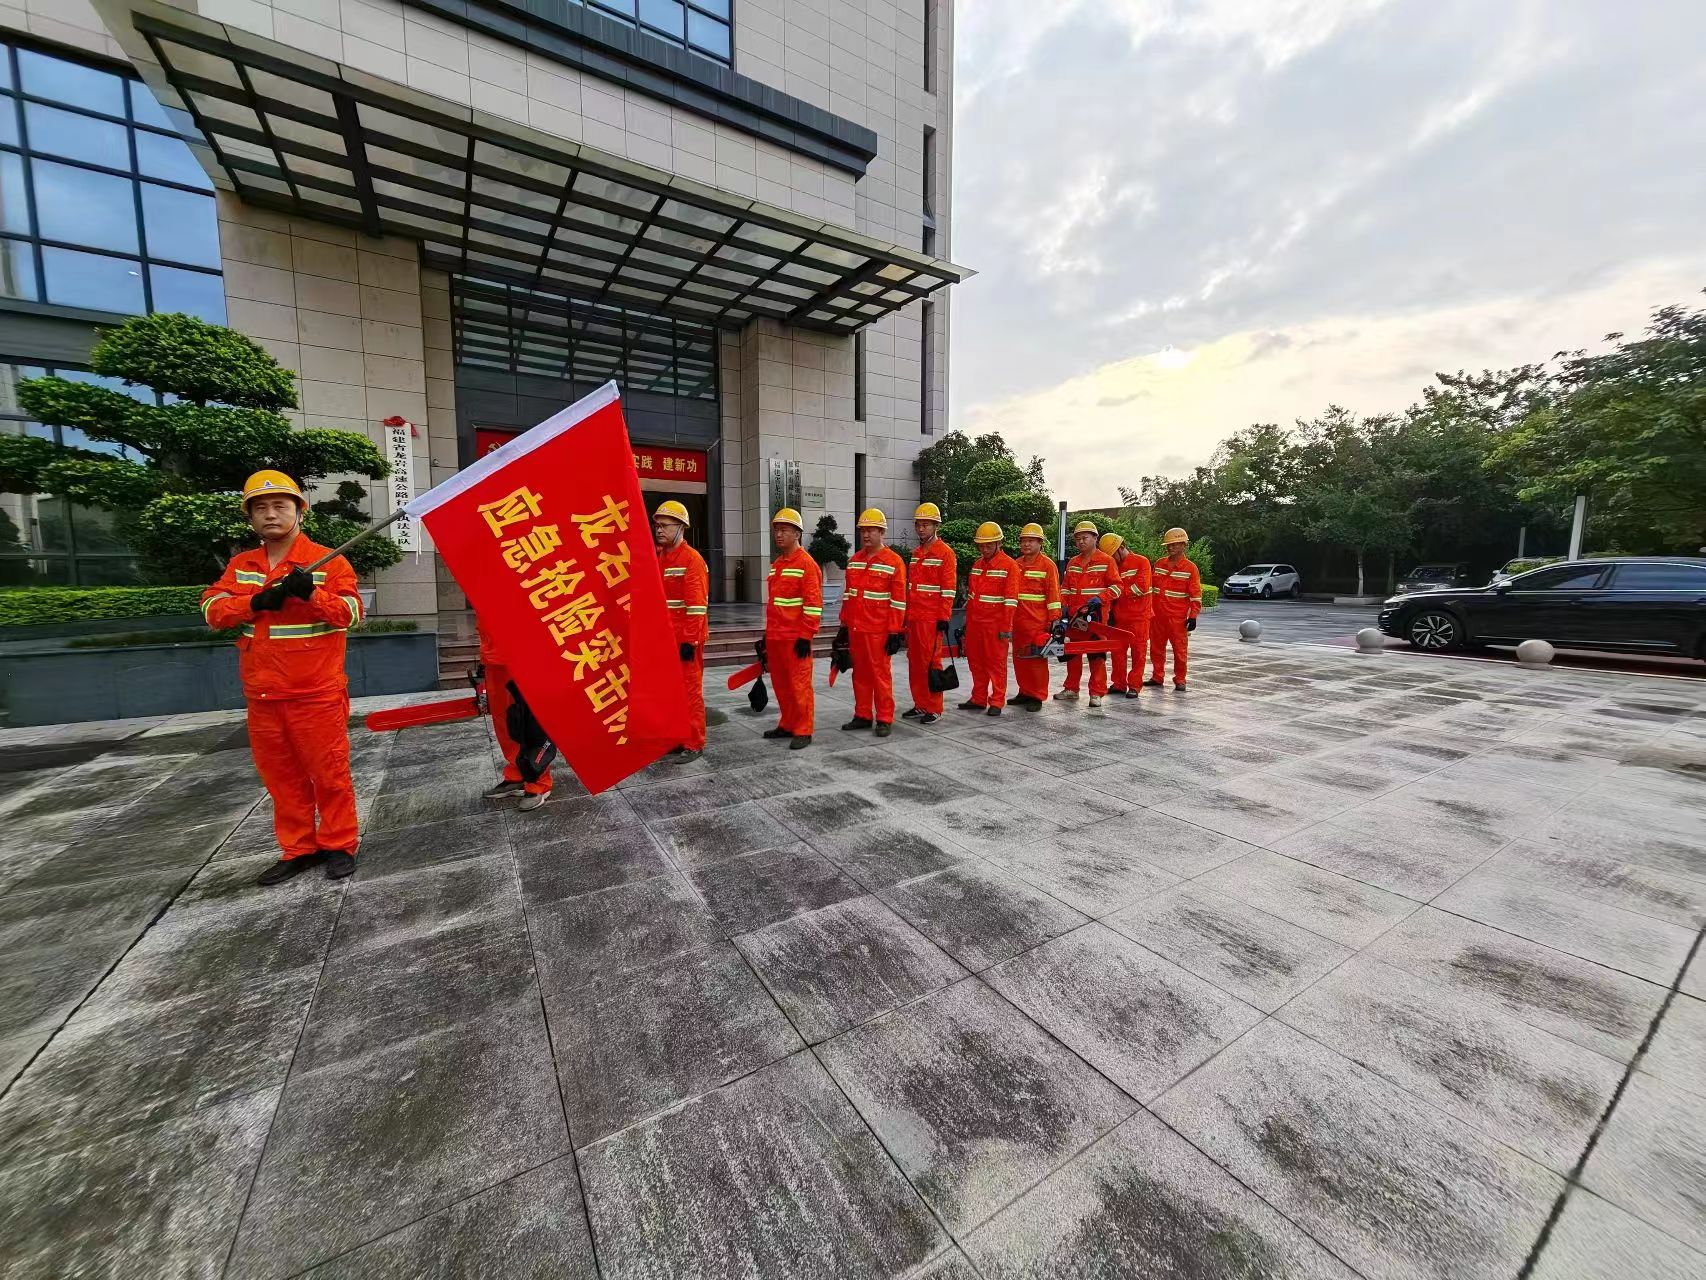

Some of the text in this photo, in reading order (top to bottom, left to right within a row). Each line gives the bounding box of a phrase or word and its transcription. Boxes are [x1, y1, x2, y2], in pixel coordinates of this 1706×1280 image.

[392, 427, 411, 545] 福建省龙岩高速公路行执法支队
[663, 457, 697, 473] 建新功
